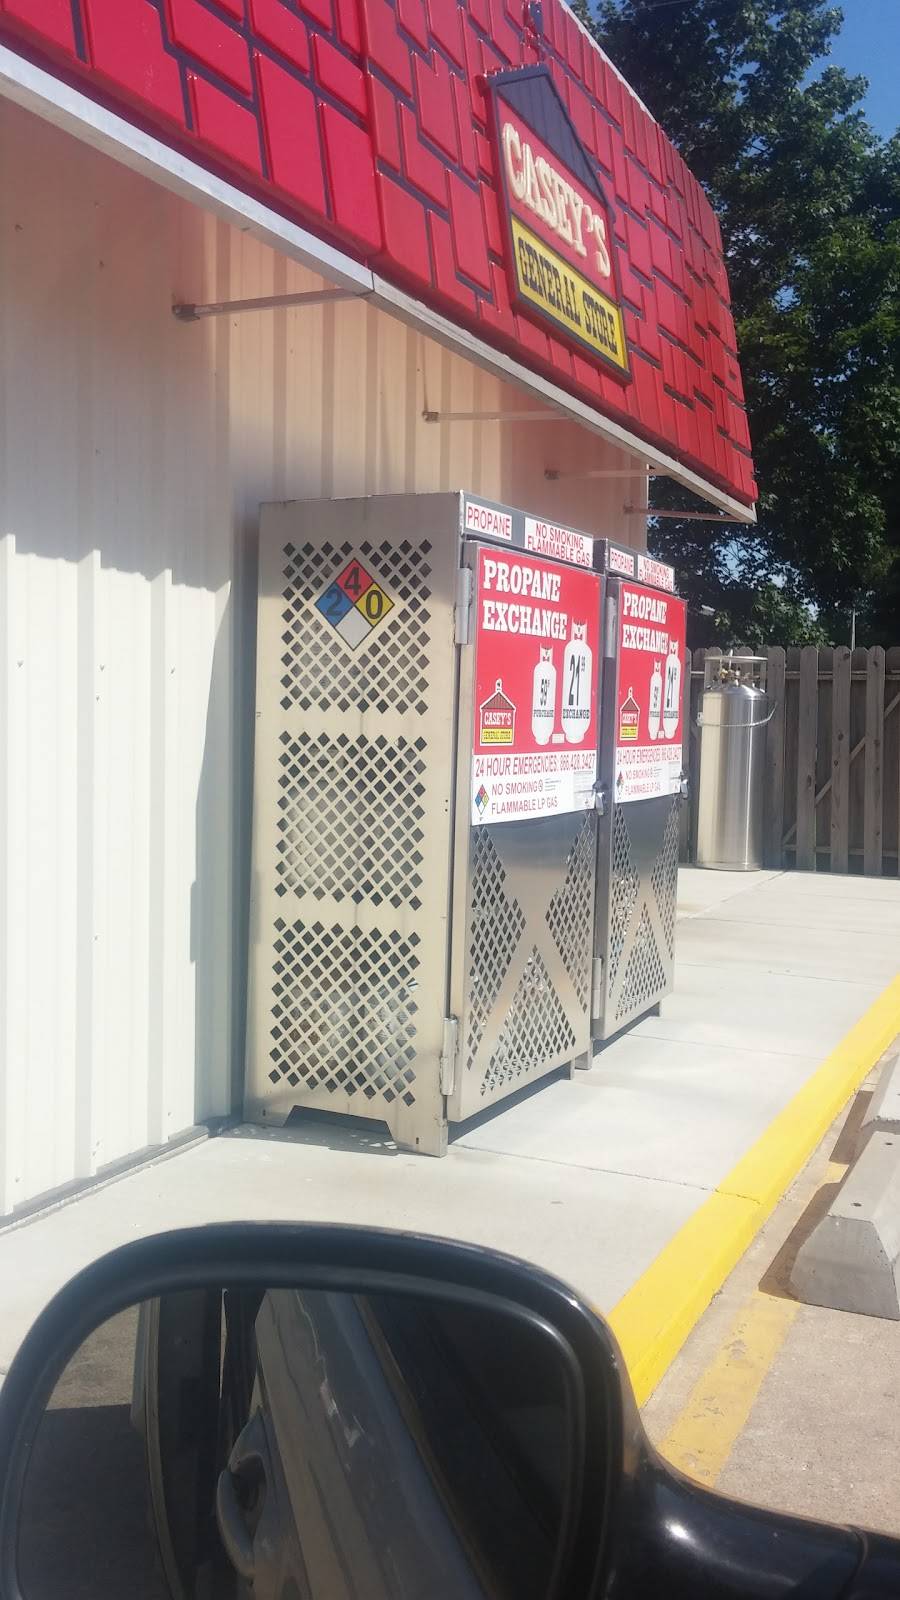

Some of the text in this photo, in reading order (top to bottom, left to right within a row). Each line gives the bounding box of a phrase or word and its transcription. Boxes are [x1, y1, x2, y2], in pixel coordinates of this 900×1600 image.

[502, 122, 611, 279] CASEY'S
[518, 236, 618, 356] GENERAL STORE
[467, 506, 511, 536] PROPANE
[535, 522, 584, 551] NO SMOKING
[527, 538, 591, 567] FLAMMABLE GAS
[343, 567, 361, 596] 4
[483, 559, 561, 603] PROPANE
[326, 588, 383, 619] 2 0
[623, 591, 667, 624] PROPANE
[482, 600, 568, 641] EXCHANGE
[622, 624, 669, 655] EXCHANGE
[484, 711, 512, 726] CASEY'S
[562, 709, 590, 720] EXCHANGE
[475, 758, 484, 777] 24
[486, 757, 511, 776] HOUR
[491, 783, 503, 796] NO
[505, 780, 537, 795] SMOKING
[491, 796, 558, 815] FLAMMABLE LP GAS
